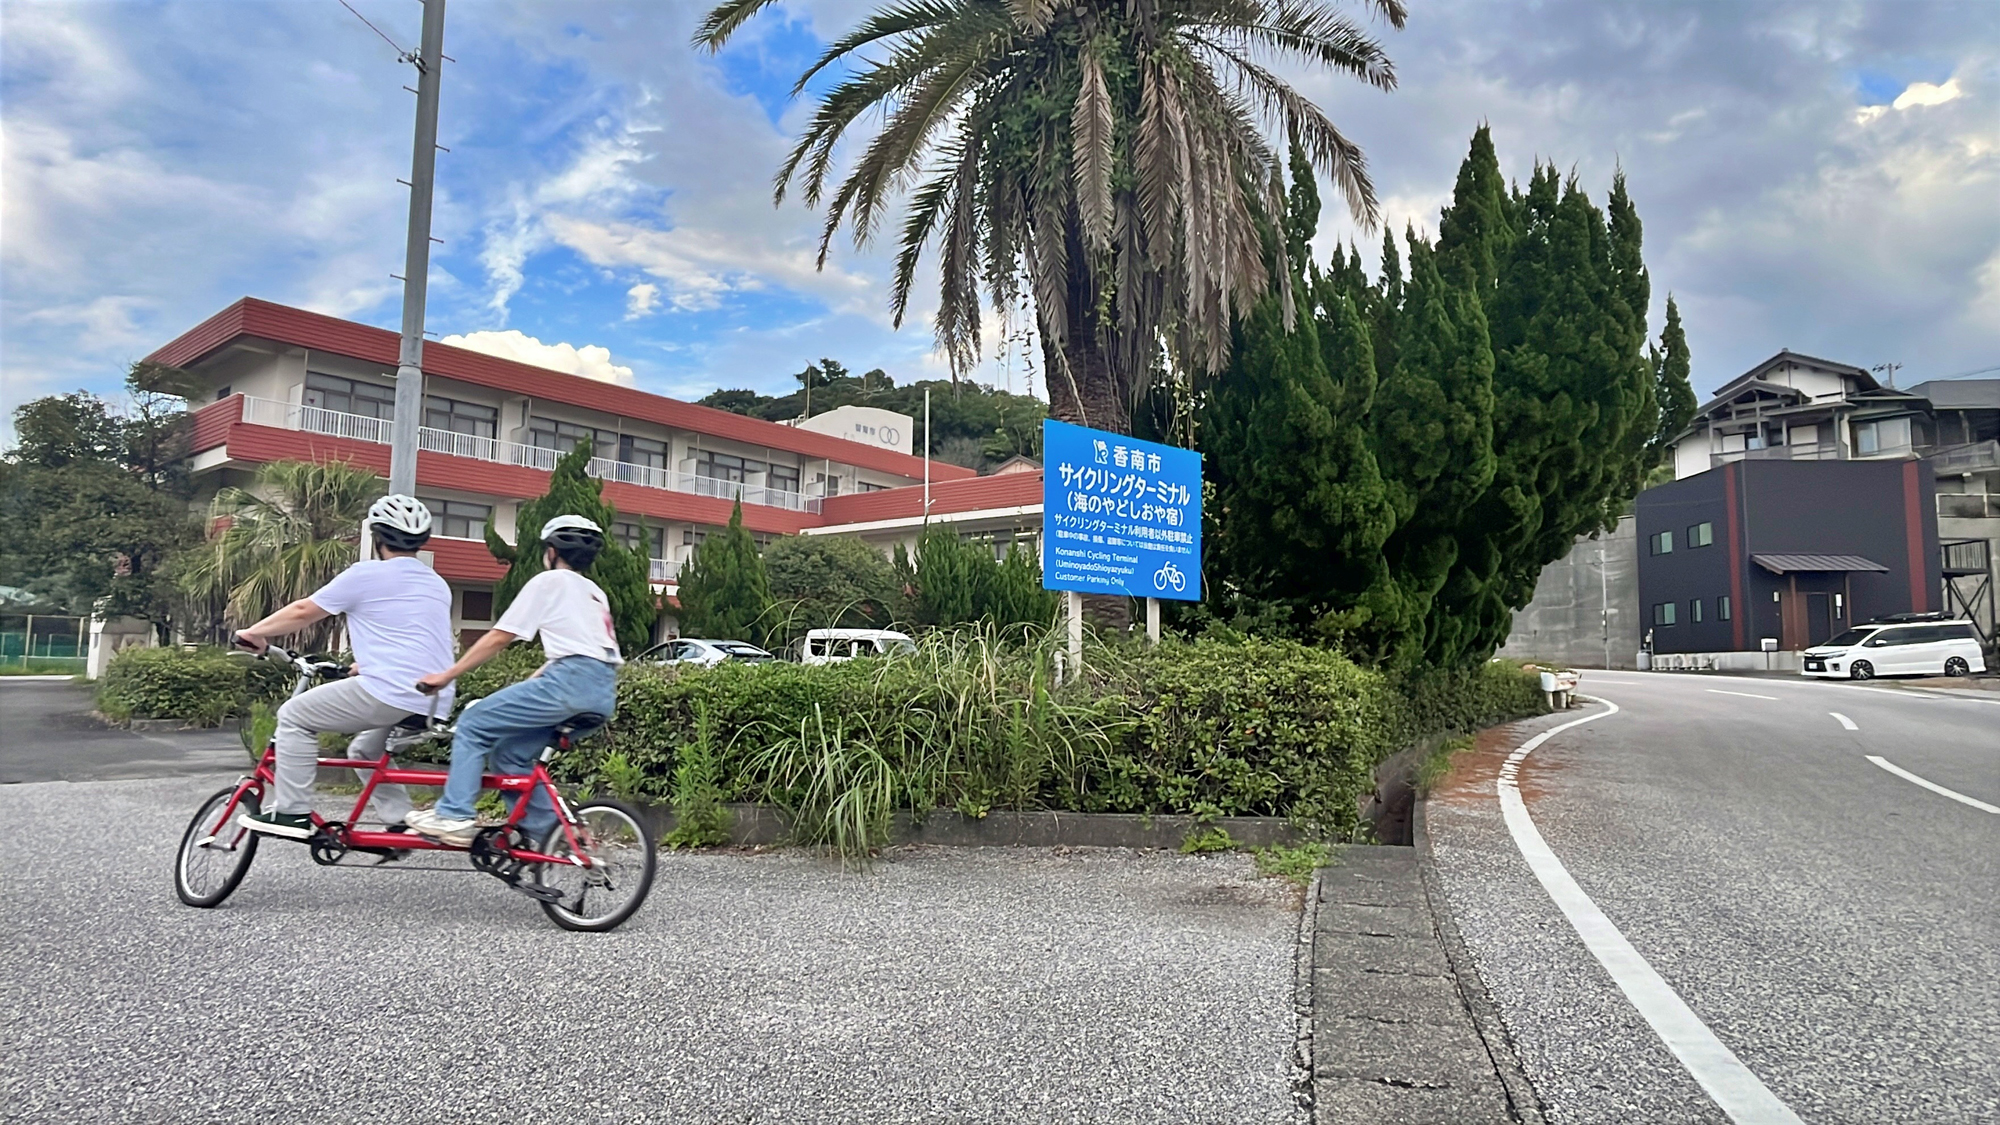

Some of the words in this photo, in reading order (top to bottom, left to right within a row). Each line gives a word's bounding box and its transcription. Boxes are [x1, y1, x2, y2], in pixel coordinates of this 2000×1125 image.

[1113, 445, 1162, 474] 香南市
[1059, 462, 1191, 507] サイクリングターミナル
[1067, 491, 1184, 527] （海のやどしおや宿）
[1054, 513, 1193, 545] サイクリングターミナル利用者以外駐車禁止
[1055, 547, 1085, 558] Konanshi
[1087, 549, 1110, 562] Cycling
[1112, 552, 1138, 563] Terminal
[1055, 571, 1085, 582] Customer
[1110, 576, 1125, 587] Only
